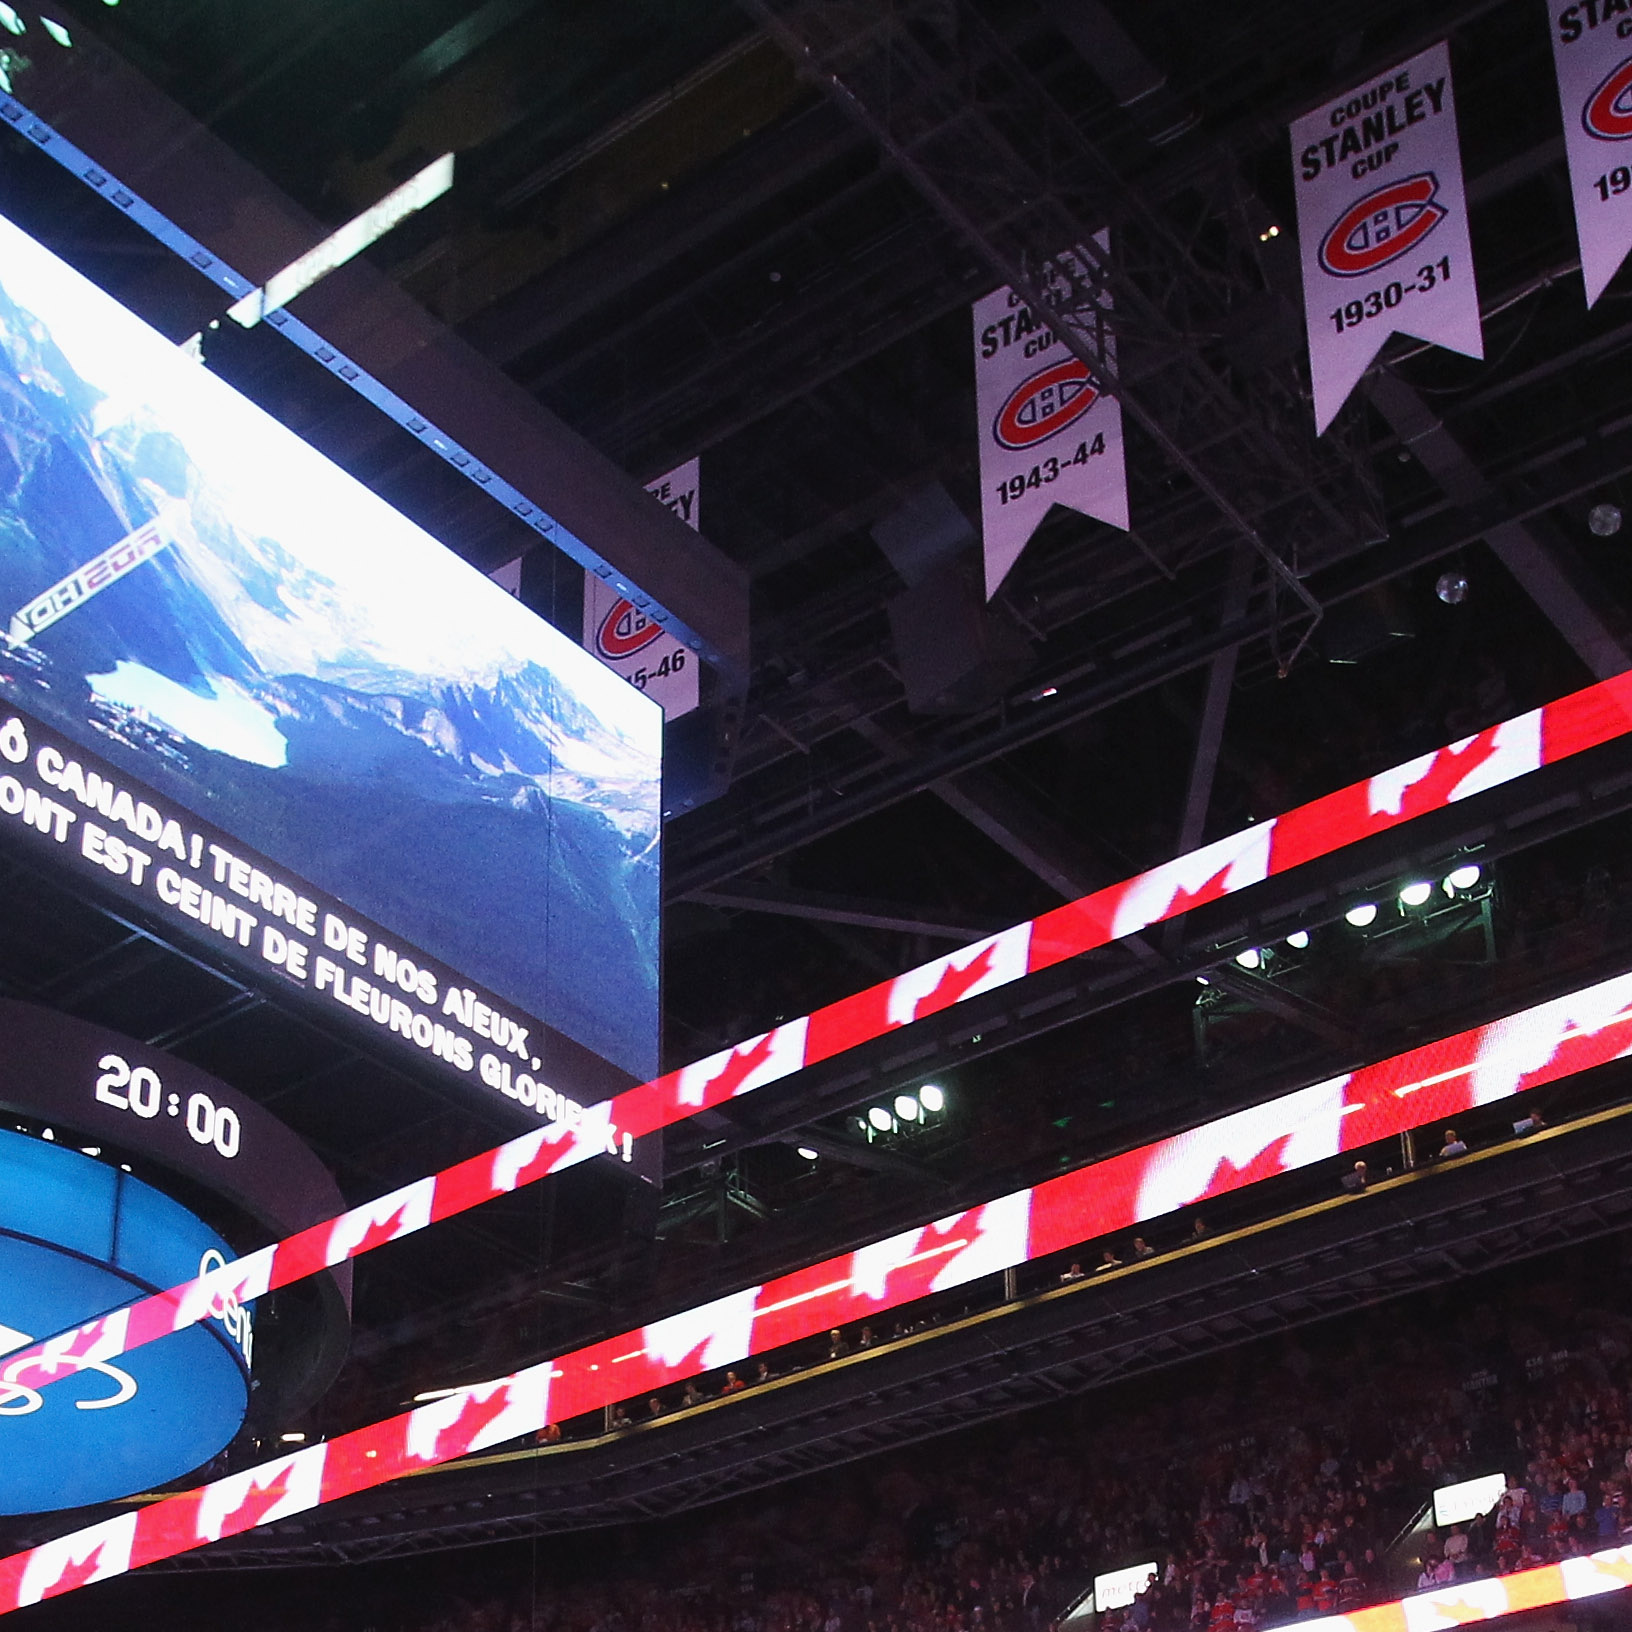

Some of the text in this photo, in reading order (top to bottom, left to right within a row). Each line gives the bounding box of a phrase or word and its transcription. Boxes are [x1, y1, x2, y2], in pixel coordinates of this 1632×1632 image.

[1301, 77, 1446, 183] STANLEY
[1329, 70, 1411, 130] COUPE
[1351, 143, 1400, 183] CUP
[1329, 255, 1453, 334] 1930-31
[995, 432, 1106, 505] 1943-44
[81, 822, 152, 886] EST
[155, 867, 258, 948] CEINT
[261, 926, 308, 980] DE
[315, 955, 475, 1072] FLEURONS
[209, 844, 317, 938] TERRE
[324, 913, 368, 966] DE
[373, 943, 438, 1004] NOS
[96, 1053, 241, 1158] 20:00
